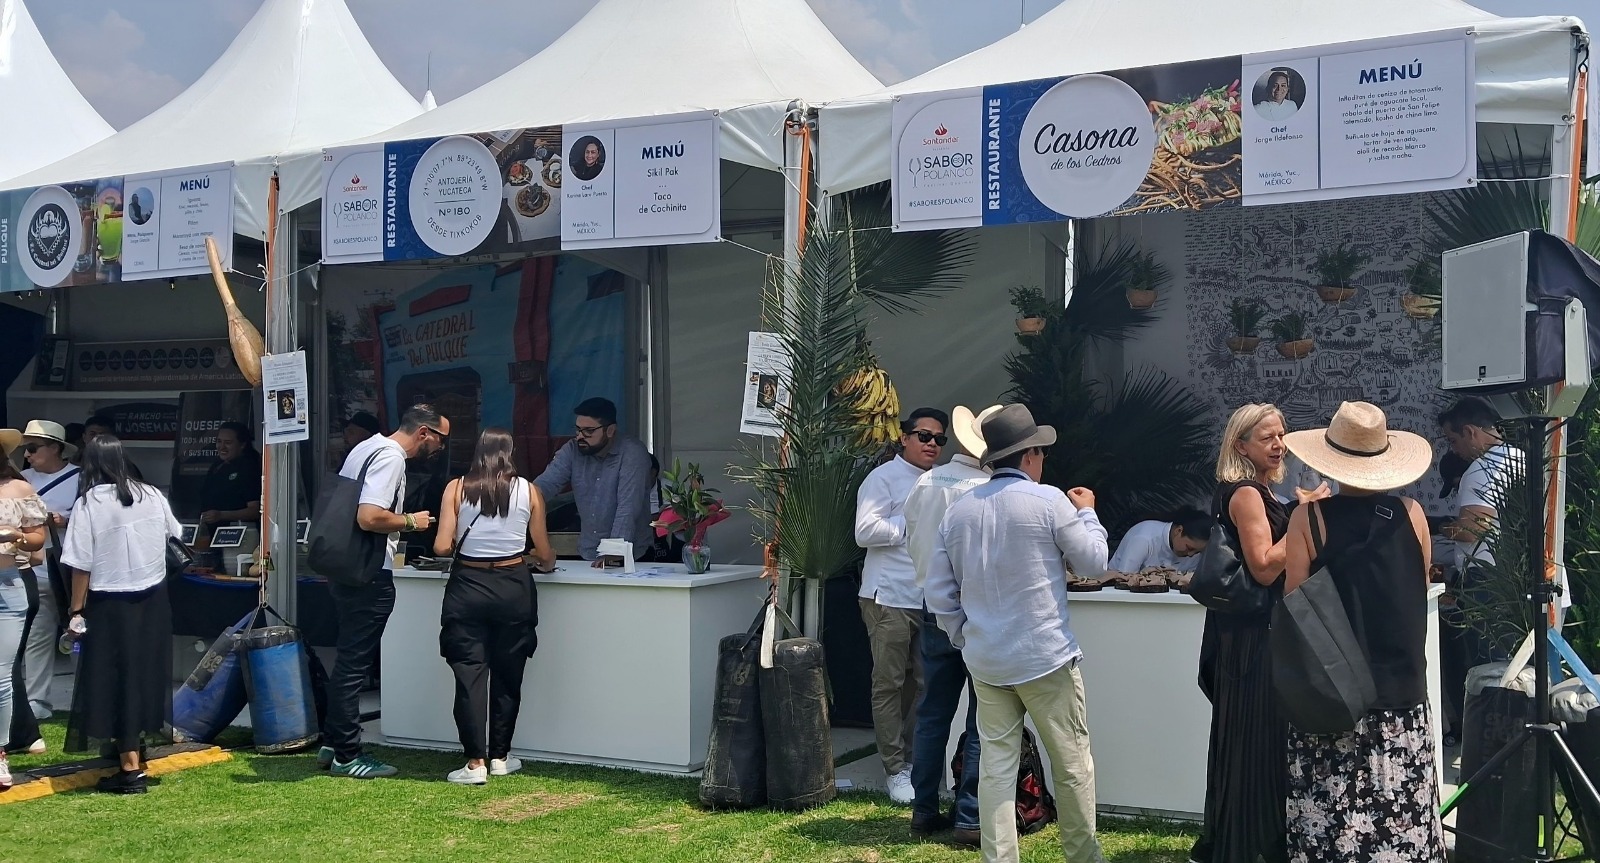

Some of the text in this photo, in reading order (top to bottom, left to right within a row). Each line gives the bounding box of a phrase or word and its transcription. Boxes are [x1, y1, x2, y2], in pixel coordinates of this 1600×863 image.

[1359, 58, 1423, 84] MENÚ
[1399, 88, 1408, 96] de
[1364, 107, 1374, 115] del
[1397, 104, 1406, 112] de
[1407, 102, 1420, 110] San
[1421, 101, 1441, 110] Felipe
[1395, 112, 1404, 120] de
[1270, 125, 1288, 134] Chef
[1371, 130, 1380, 138] de
[1380, 128, 1395, 138] hoja
[1396, 127, 1405, 135] de
[922, 136, 960, 146] Santander
[1033, 123, 1140, 155] Casona
[1254, 133, 1304, 145] Jorge Ildefonso
[1383, 137, 1392, 145] de
[641, 140, 685, 160] MENÚ
[988, 98, 1001, 210] RESTAURANTE
[1371, 146, 1380, 154] de
[1404, 142, 1427, 151] blanco
[923, 152, 974, 169] SABOR
[1050, 154, 1122, 171] de los Cedros
[647, 166, 679, 178] Sikil Pak
[923, 167, 974, 181] POLANCO
[180, 174, 210, 192] MENÚ
[437, 174, 473, 186] ANTOJERÍA
[342, 185, 368, 193] Santander
[438, 186, 472, 196] YUCATECA
[581, 184, 593, 192] Chef
[387, 153, 397, 248] RESTAURANTE
[653, 192, 672, 201] Taco
[908, 196, 974, 208] #SABORESPOLANCO
[343, 198, 378, 212] SABOR
[453, 206, 471, 216] 180
[638, 203, 687, 214] de Cochinita
[343, 211, 378, 222] POLANCO
[427, 214, 482, 239] DESDE TIXKOKOB
[415, 309, 476, 342] CATEDRAL
[425, 335, 469, 365] PULQUE
[127, 412, 162, 421] RANCHO
[125, 421, 177, 433] JOSEMAR
